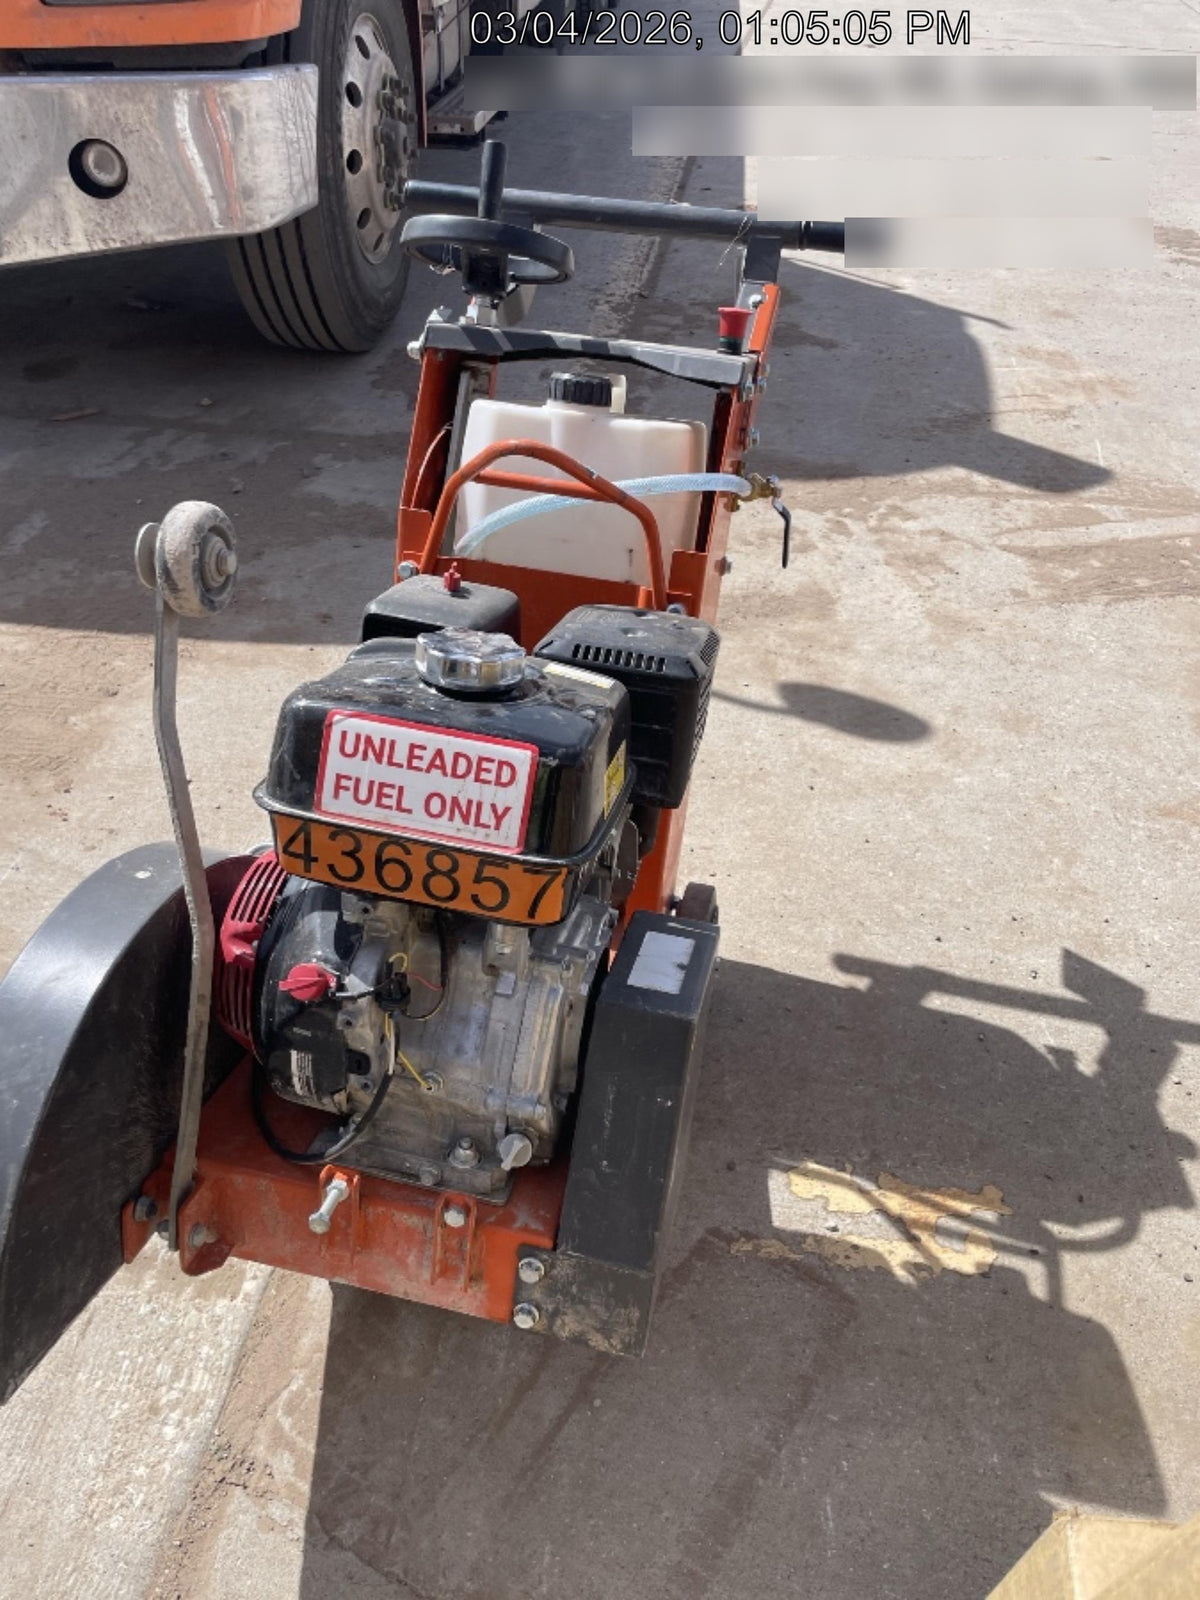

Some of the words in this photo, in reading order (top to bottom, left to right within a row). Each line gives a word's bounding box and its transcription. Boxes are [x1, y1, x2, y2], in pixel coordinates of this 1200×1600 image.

[338, 730, 518, 788] UNLEADED
[332, 772, 413, 814] FUEL
[423, 792, 512, 831] ONLY
[281, 823, 566, 920] 436857
